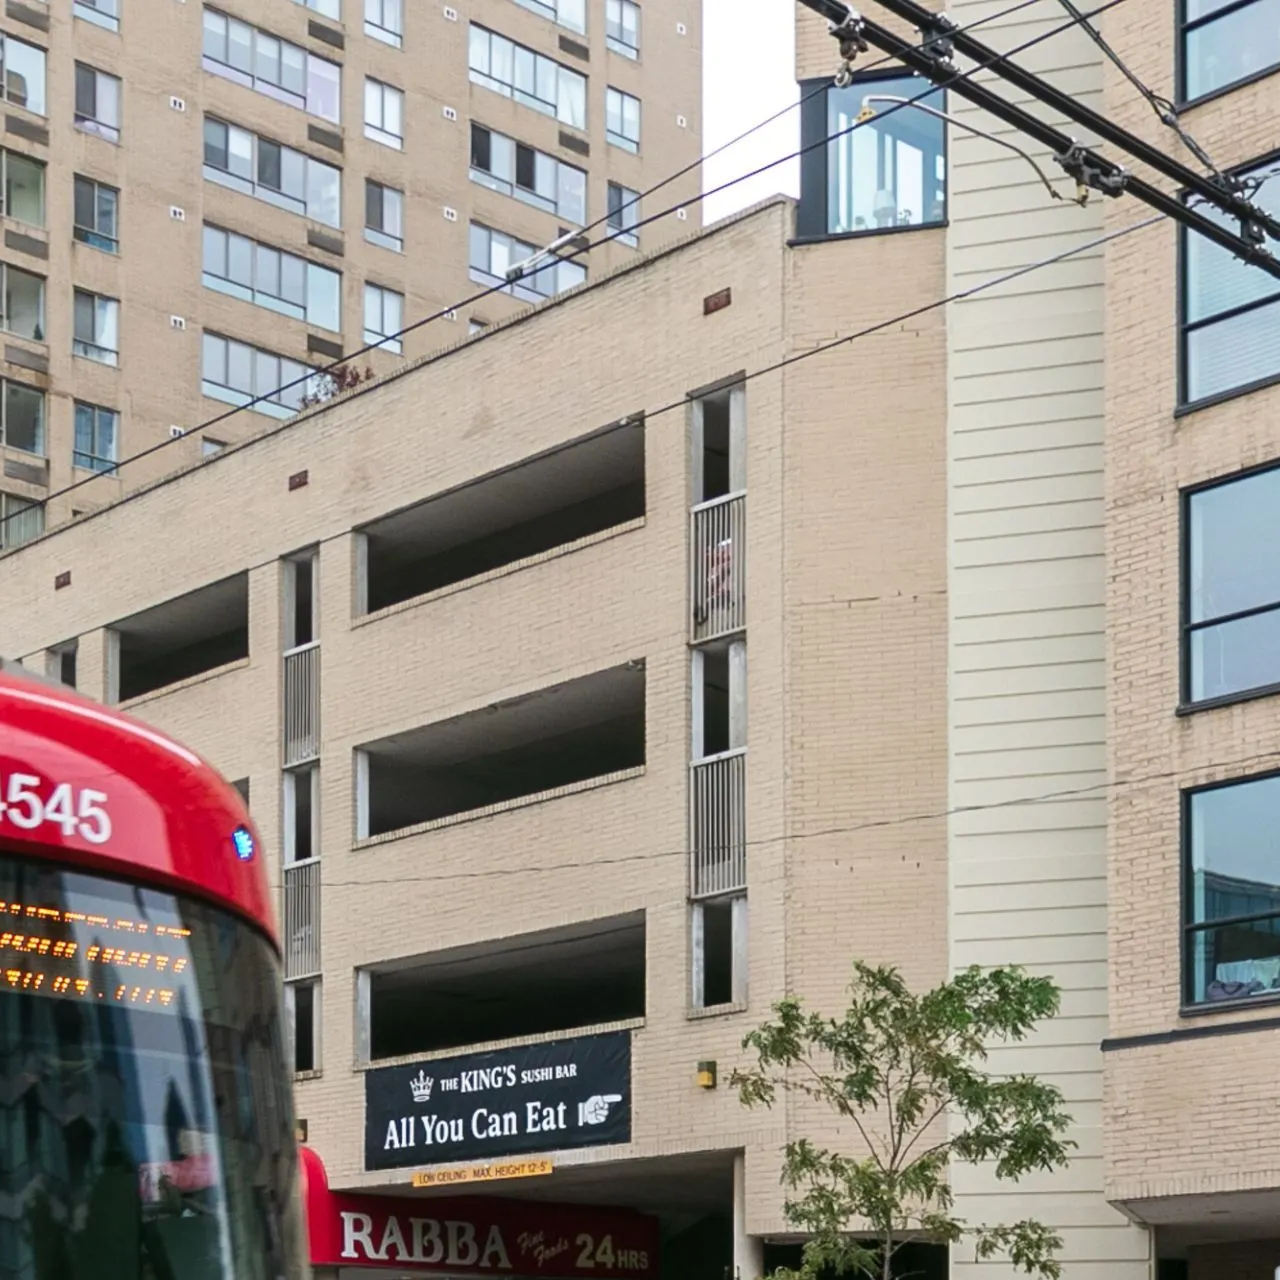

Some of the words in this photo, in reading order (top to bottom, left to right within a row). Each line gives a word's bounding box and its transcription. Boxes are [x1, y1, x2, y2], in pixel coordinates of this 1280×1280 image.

[440, 1078, 459, 1092] THE
[460, 1064, 517, 1093] KING'S
[521, 1066, 553, 1084] SUSHI
[555, 1063, 578, 1080] BAR
[384, 1116, 415, 1150] All
[421, 1114, 464, 1144] You
[471, 1108, 518, 1139] Can
[526, 1101, 567, 1133] Eat
[419, 1173, 435, 1184] LOW
[436, 1170, 466, 1182] CEILING
[495, 1163, 526, 1176] HEIGHT
[340, 1211, 513, 1269] RABBA
[576, 1233, 616, 1269] 24
[617, 1248, 650, 1270] HRS
